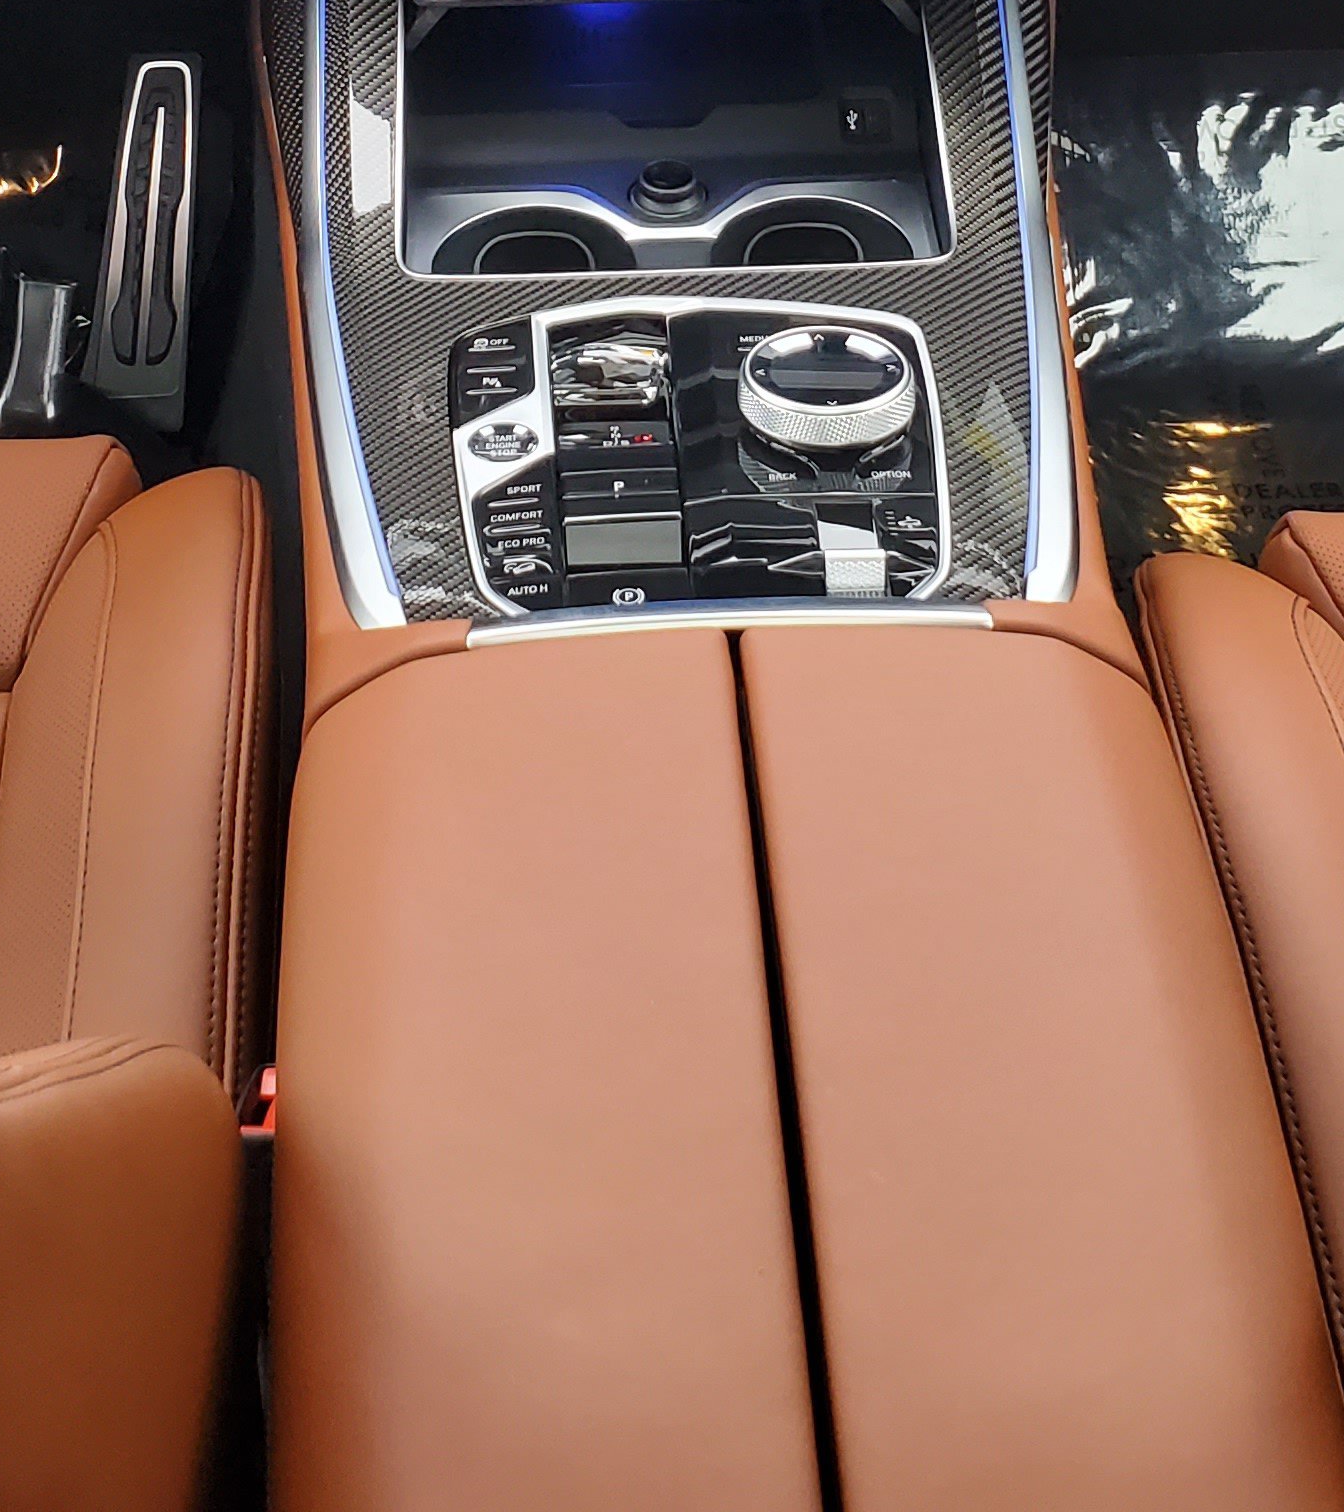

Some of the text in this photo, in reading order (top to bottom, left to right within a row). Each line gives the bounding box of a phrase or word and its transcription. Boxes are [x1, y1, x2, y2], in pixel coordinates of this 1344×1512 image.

[490, 338, 509, 346] OFF
[488, 434, 517, 442] START
[485, 441, 521, 450] ENGINE
[490, 448, 518, 456] STOP
[768, 472, 797, 481] BACK
[871, 470, 912, 479] OPTION
[506, 483, 542, 495] SPORT
[613, 481, 625, 492] P
[1233, 481, 1342, 501] DEALER
[490, 510, 544, 523] COMFORT
[497, 536, 545, 548] ECO PRO
[507, 583, 548, 596] AUTO H
